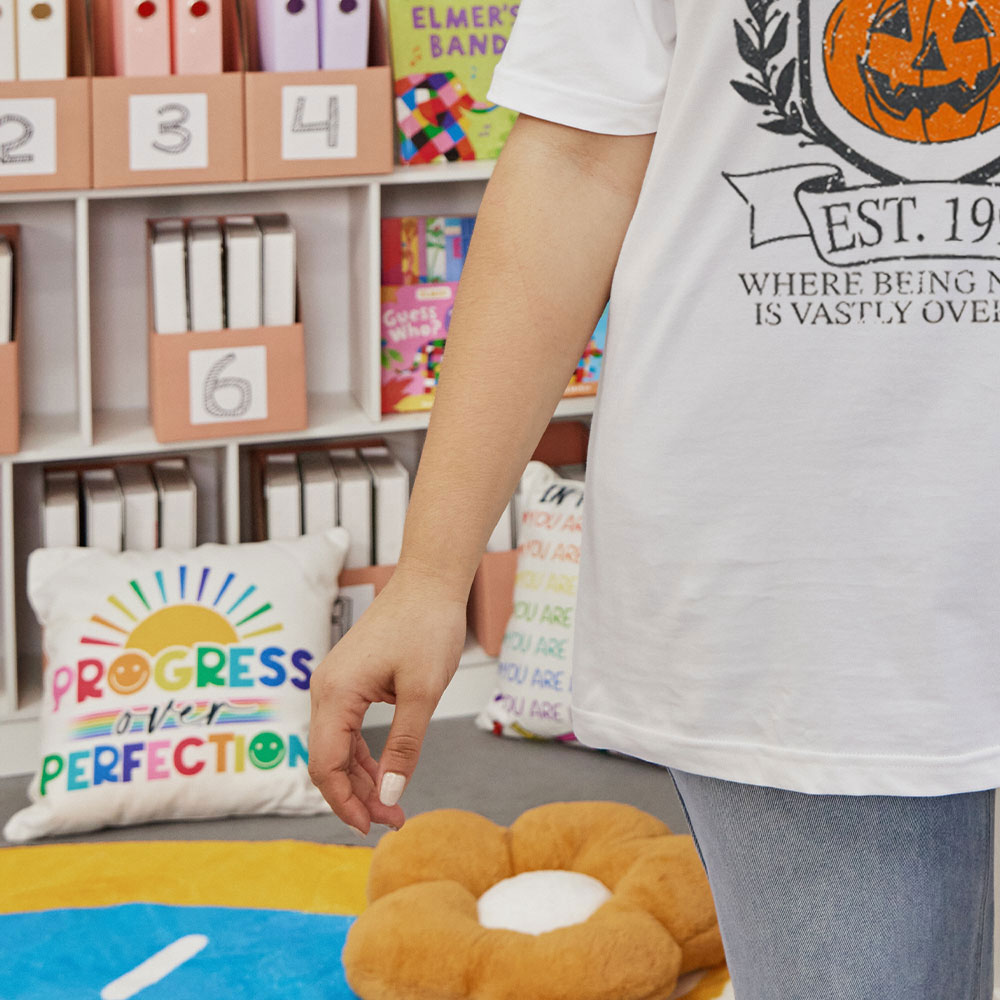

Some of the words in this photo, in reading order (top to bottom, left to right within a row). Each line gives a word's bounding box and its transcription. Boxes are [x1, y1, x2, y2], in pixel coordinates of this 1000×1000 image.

[429, 34, 508, 58] BAND
[152, 103, 192, 153] 3
[291, 96, 339, 147] 4
[0, 113, 35, 164] 2
[820, 197, 925, 254] EST.
[738, 272, 863, 297] WHERE
[872, 270, 976, 296] BEING
[383, 306, 438, 328] Guess
[754, 301, 782, 326] IS
[790, 300, 909, 326] VASTLY
[388, 319, 442, 342] Who?
[203, 352, 253, 417] 6
[531, 667, 565, 692] ARE
[116, 700, 230, 735] over
